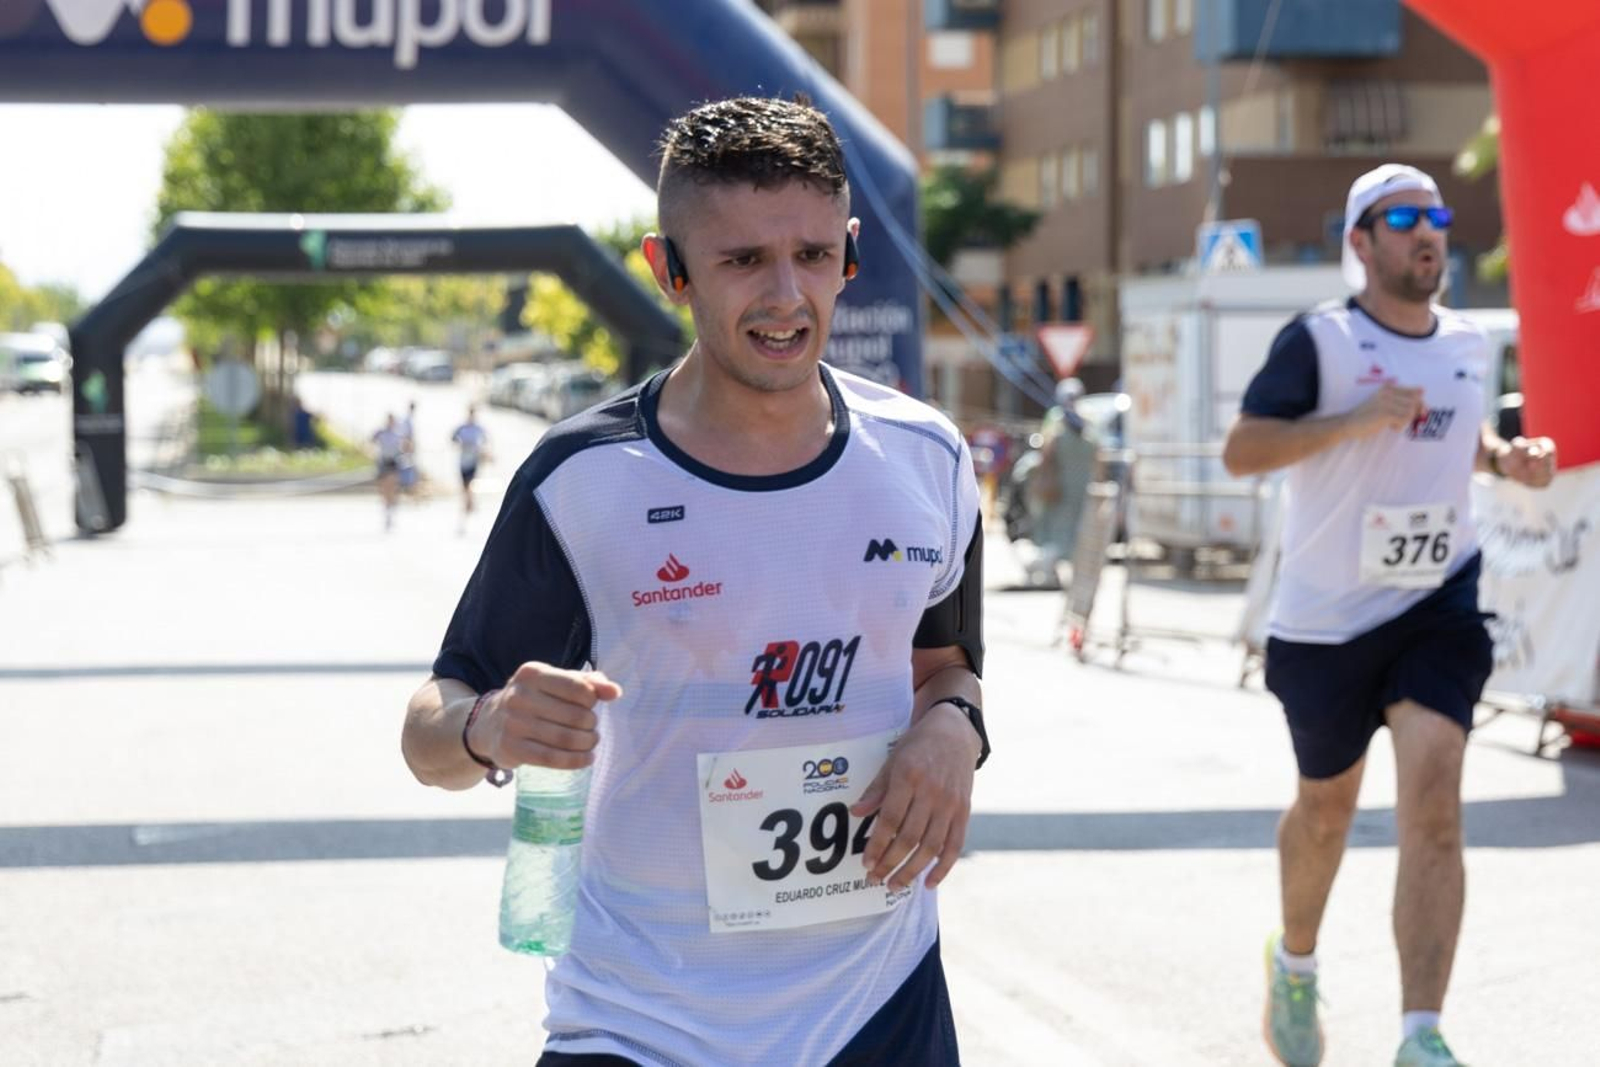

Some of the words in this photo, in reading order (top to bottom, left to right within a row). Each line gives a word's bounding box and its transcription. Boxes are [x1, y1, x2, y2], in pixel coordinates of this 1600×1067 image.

[650, 508, 682, 521] 42K
[1382, 531, 1450, 567] 376
[631, 581, 722, 606] Santander
[803, 756, 849, 779] 200
[708, 789, 764, 802] Santander
[775, 885, 823, 903] EDUARDO
[825, 880, 851, 896] CRUZ
